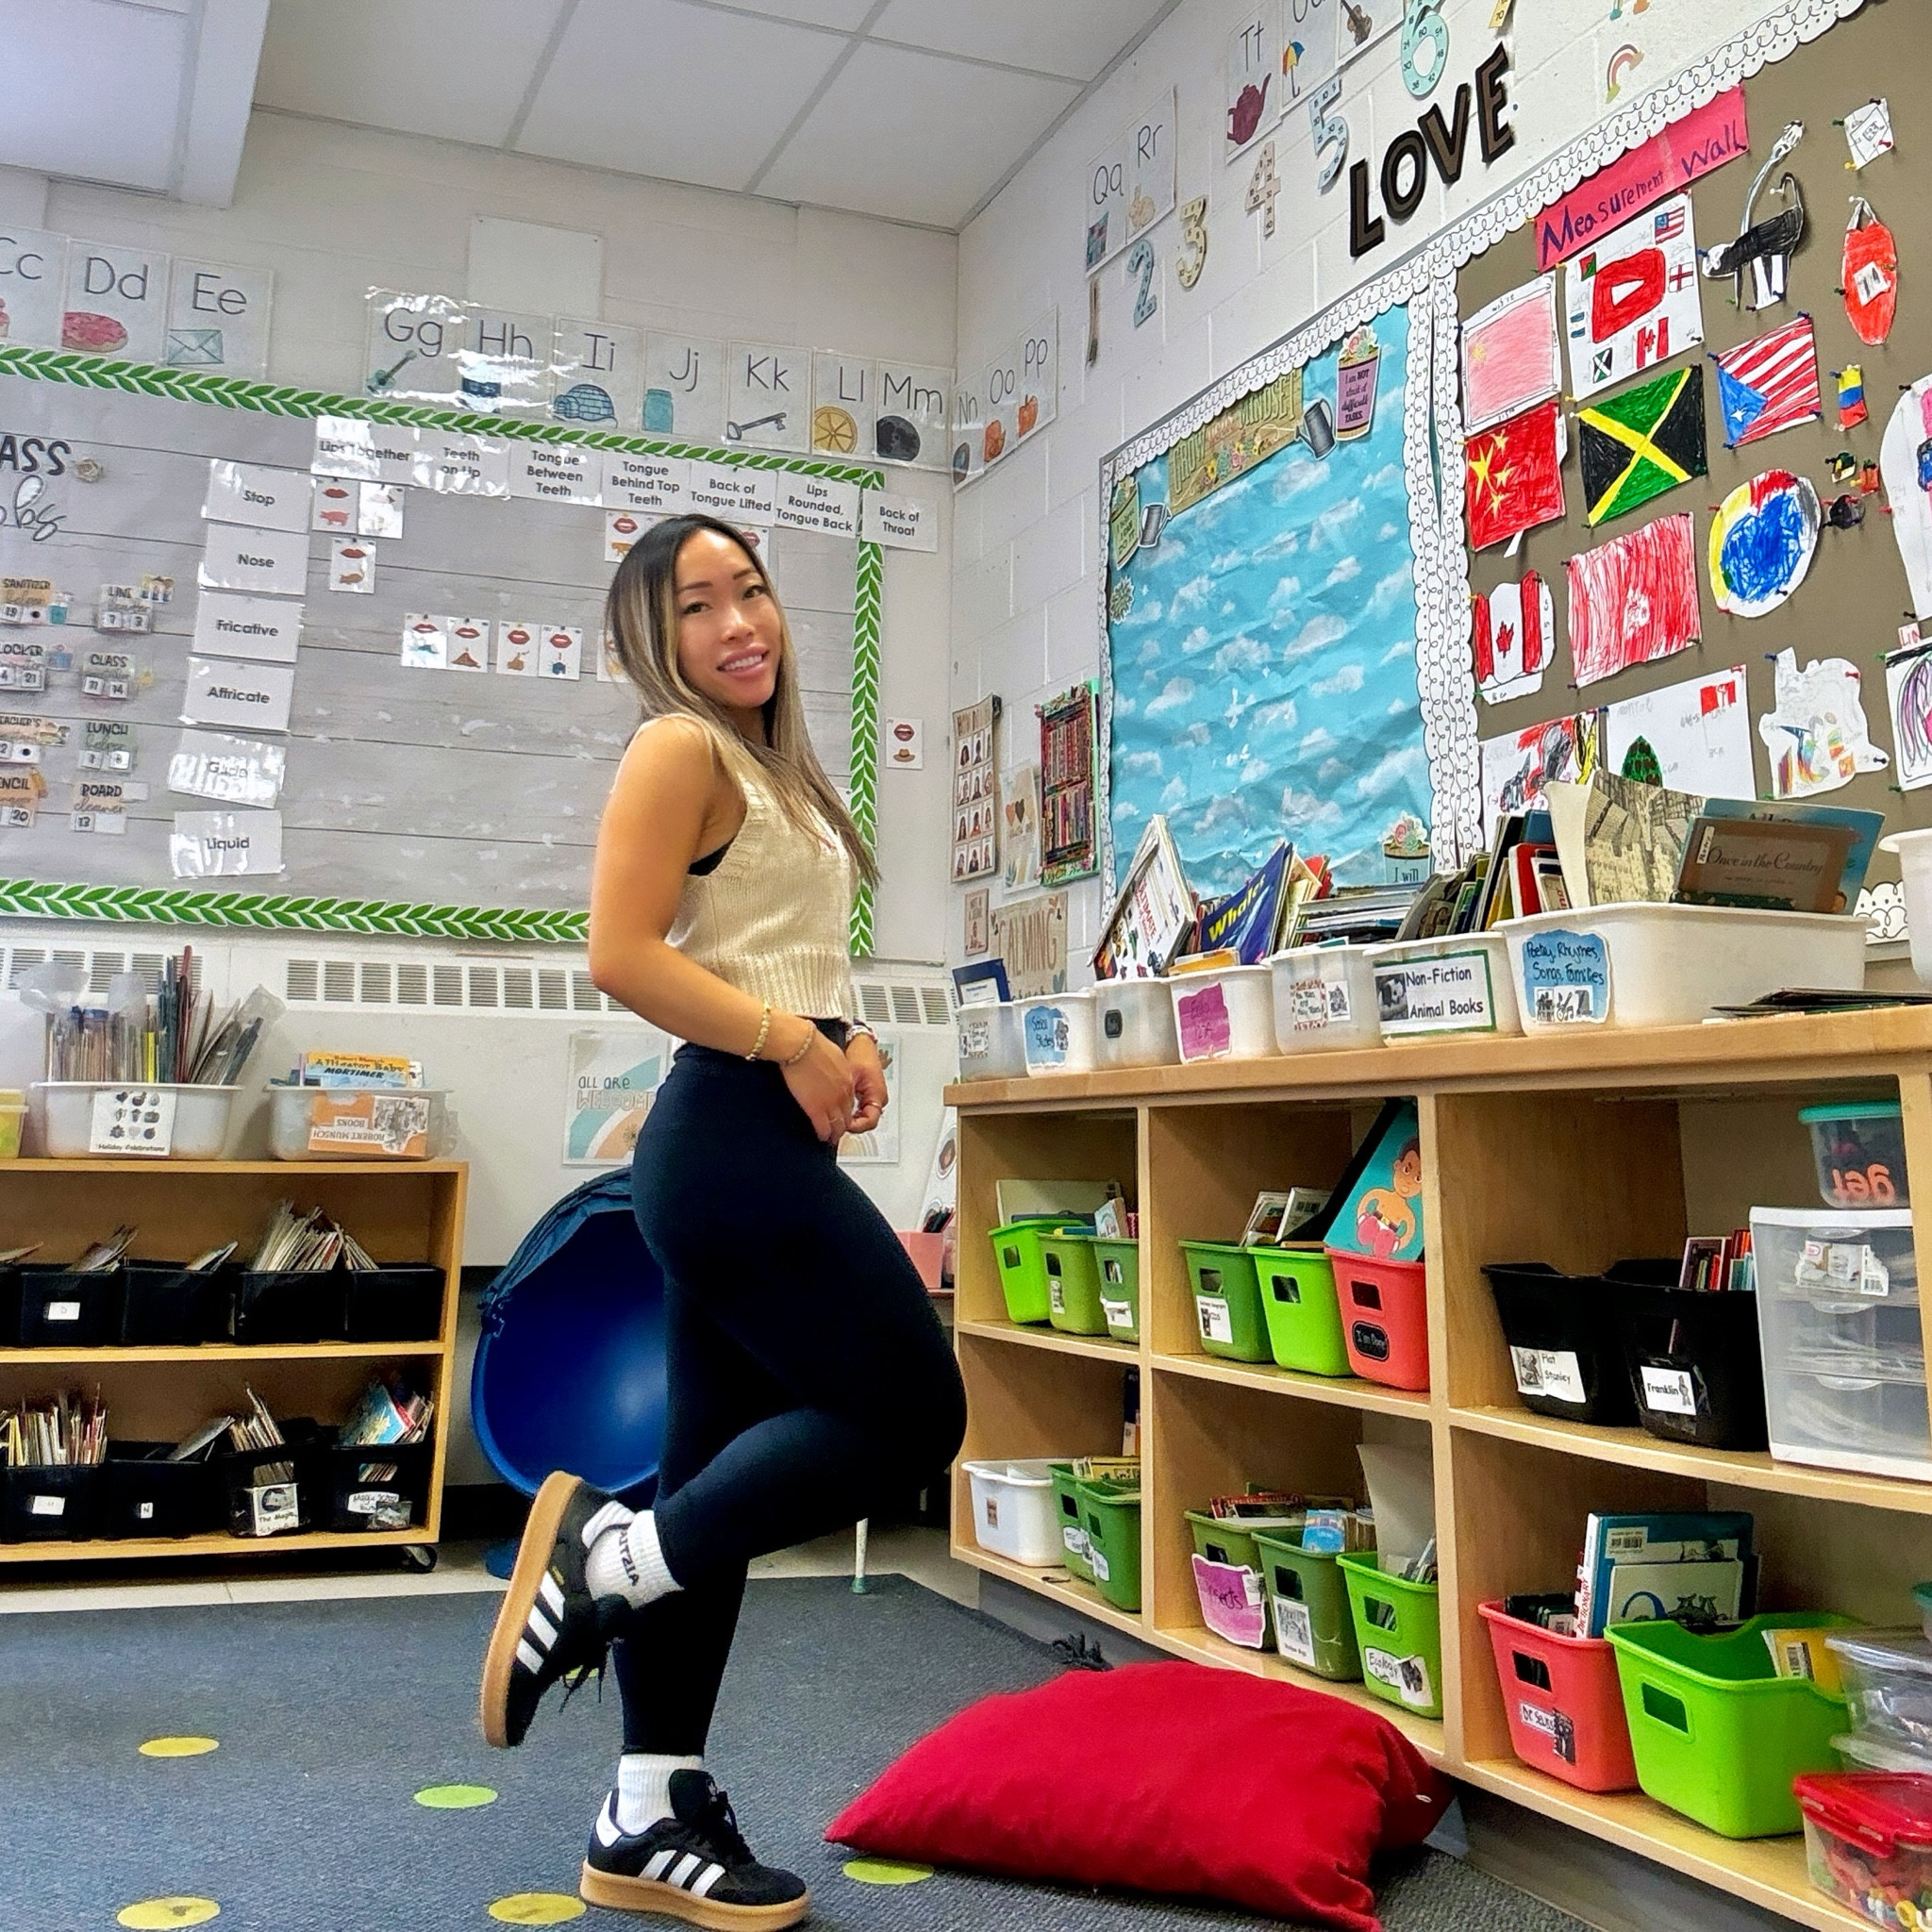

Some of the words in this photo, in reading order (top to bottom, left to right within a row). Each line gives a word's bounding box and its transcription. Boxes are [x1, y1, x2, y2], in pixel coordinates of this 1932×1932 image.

[1240, 21, 1264, 72] Tt
[1308, 75, 1348, 191] 5
[1138, 125, 1162, 168] Rr
[1350, 42, 1514, 258] LOVE
[1541, 171, 1664, 266] Measurement
[1681, 119, 1747, 178] Wall
[1176, 194, 1207, 288] 3
[84, 257, 149, 301] Dd
[1127, 240, 1157, 327] 2
[192, 272, 247, 315] Ee
[383, 307, 444, 358] Gg
[480, 319, 534, 360] Hh
[581, 332, 616, 372] Ii
[669, 346, 700, 392] Jj
[747, 354, 791, 392] Kk
[840, 366, 864, 403] Ll
[884, 373, 942, 414] Mm
[991, 369, 1015, 404] Oo
[320, 441, 344, 454] Lips
[350, 443, 410, 463] Together
[443, 447, 479, 462] Teeth
[532, 450, 579, 467] Tongue
[527, 466, 583, 482] Between
[623, 461, 669, 477] Tongue
[537, 482, 571, 496] Teeth
[612, 475, 654, 491] Behind
[658, 479, 680, 494] Top
[709, 478, 738, 493] Back
[743, 482, 756, 494] of
[807, 484, 828, 499] Lips
[243, 490, 275, 508] Stop
[628, 492, 662, 507] Teeth
[691, 491, 736, 508] Tongue
[740, 497, 772, 512] Lifted
[789, 495, 844, 517] Rounded,
[776, 508, 820, 527] Tongue
[824, 516, 853, 533] Back
[879, 506, 903, 521] Back
[907, 510, 920, 524] of
[883, 521, 916, 537] Throat
[238, 553, 275, 569] Nose
[215, 619, 279, 638] Fricative
[90, 653, 128, 668] CLASS
[207, 686, 271, 705] Affricate
[87, 723, 128, 736] LUNCH
[82, 783, 122, 797] BOARD
[12, 808, 28, 822] 20
[206, 837, 250, 852] Liquid
[1707, 846, 1739, 868] Once
[1754, 852, 1774, 869] the
[1774, 852, 1824, 876] Country
[1394, 867, 1398, 882] I
[1402, 868, 1419, 882] will
[1557, 942, 1601, 965] Rhymes,
[1406, 966, 1472, 988] Non-Fiction
[1409, 1001, 1444, 1019] Animal
[1449, 998, 1483, 1016] Books
[324, 1067, 385, 1078] MORTIMER
[375, 1061, 405, 1073] Baby
[336, 1118, 365, 1127] BOOKS
[313, 1129, 350, 1141] MUNSCH
[350, 1131, 385, 1141] ROBERT
[1541, 1353, 1556, 1364] Flat
[1647, 1382, 1678, 1395] Franklin
